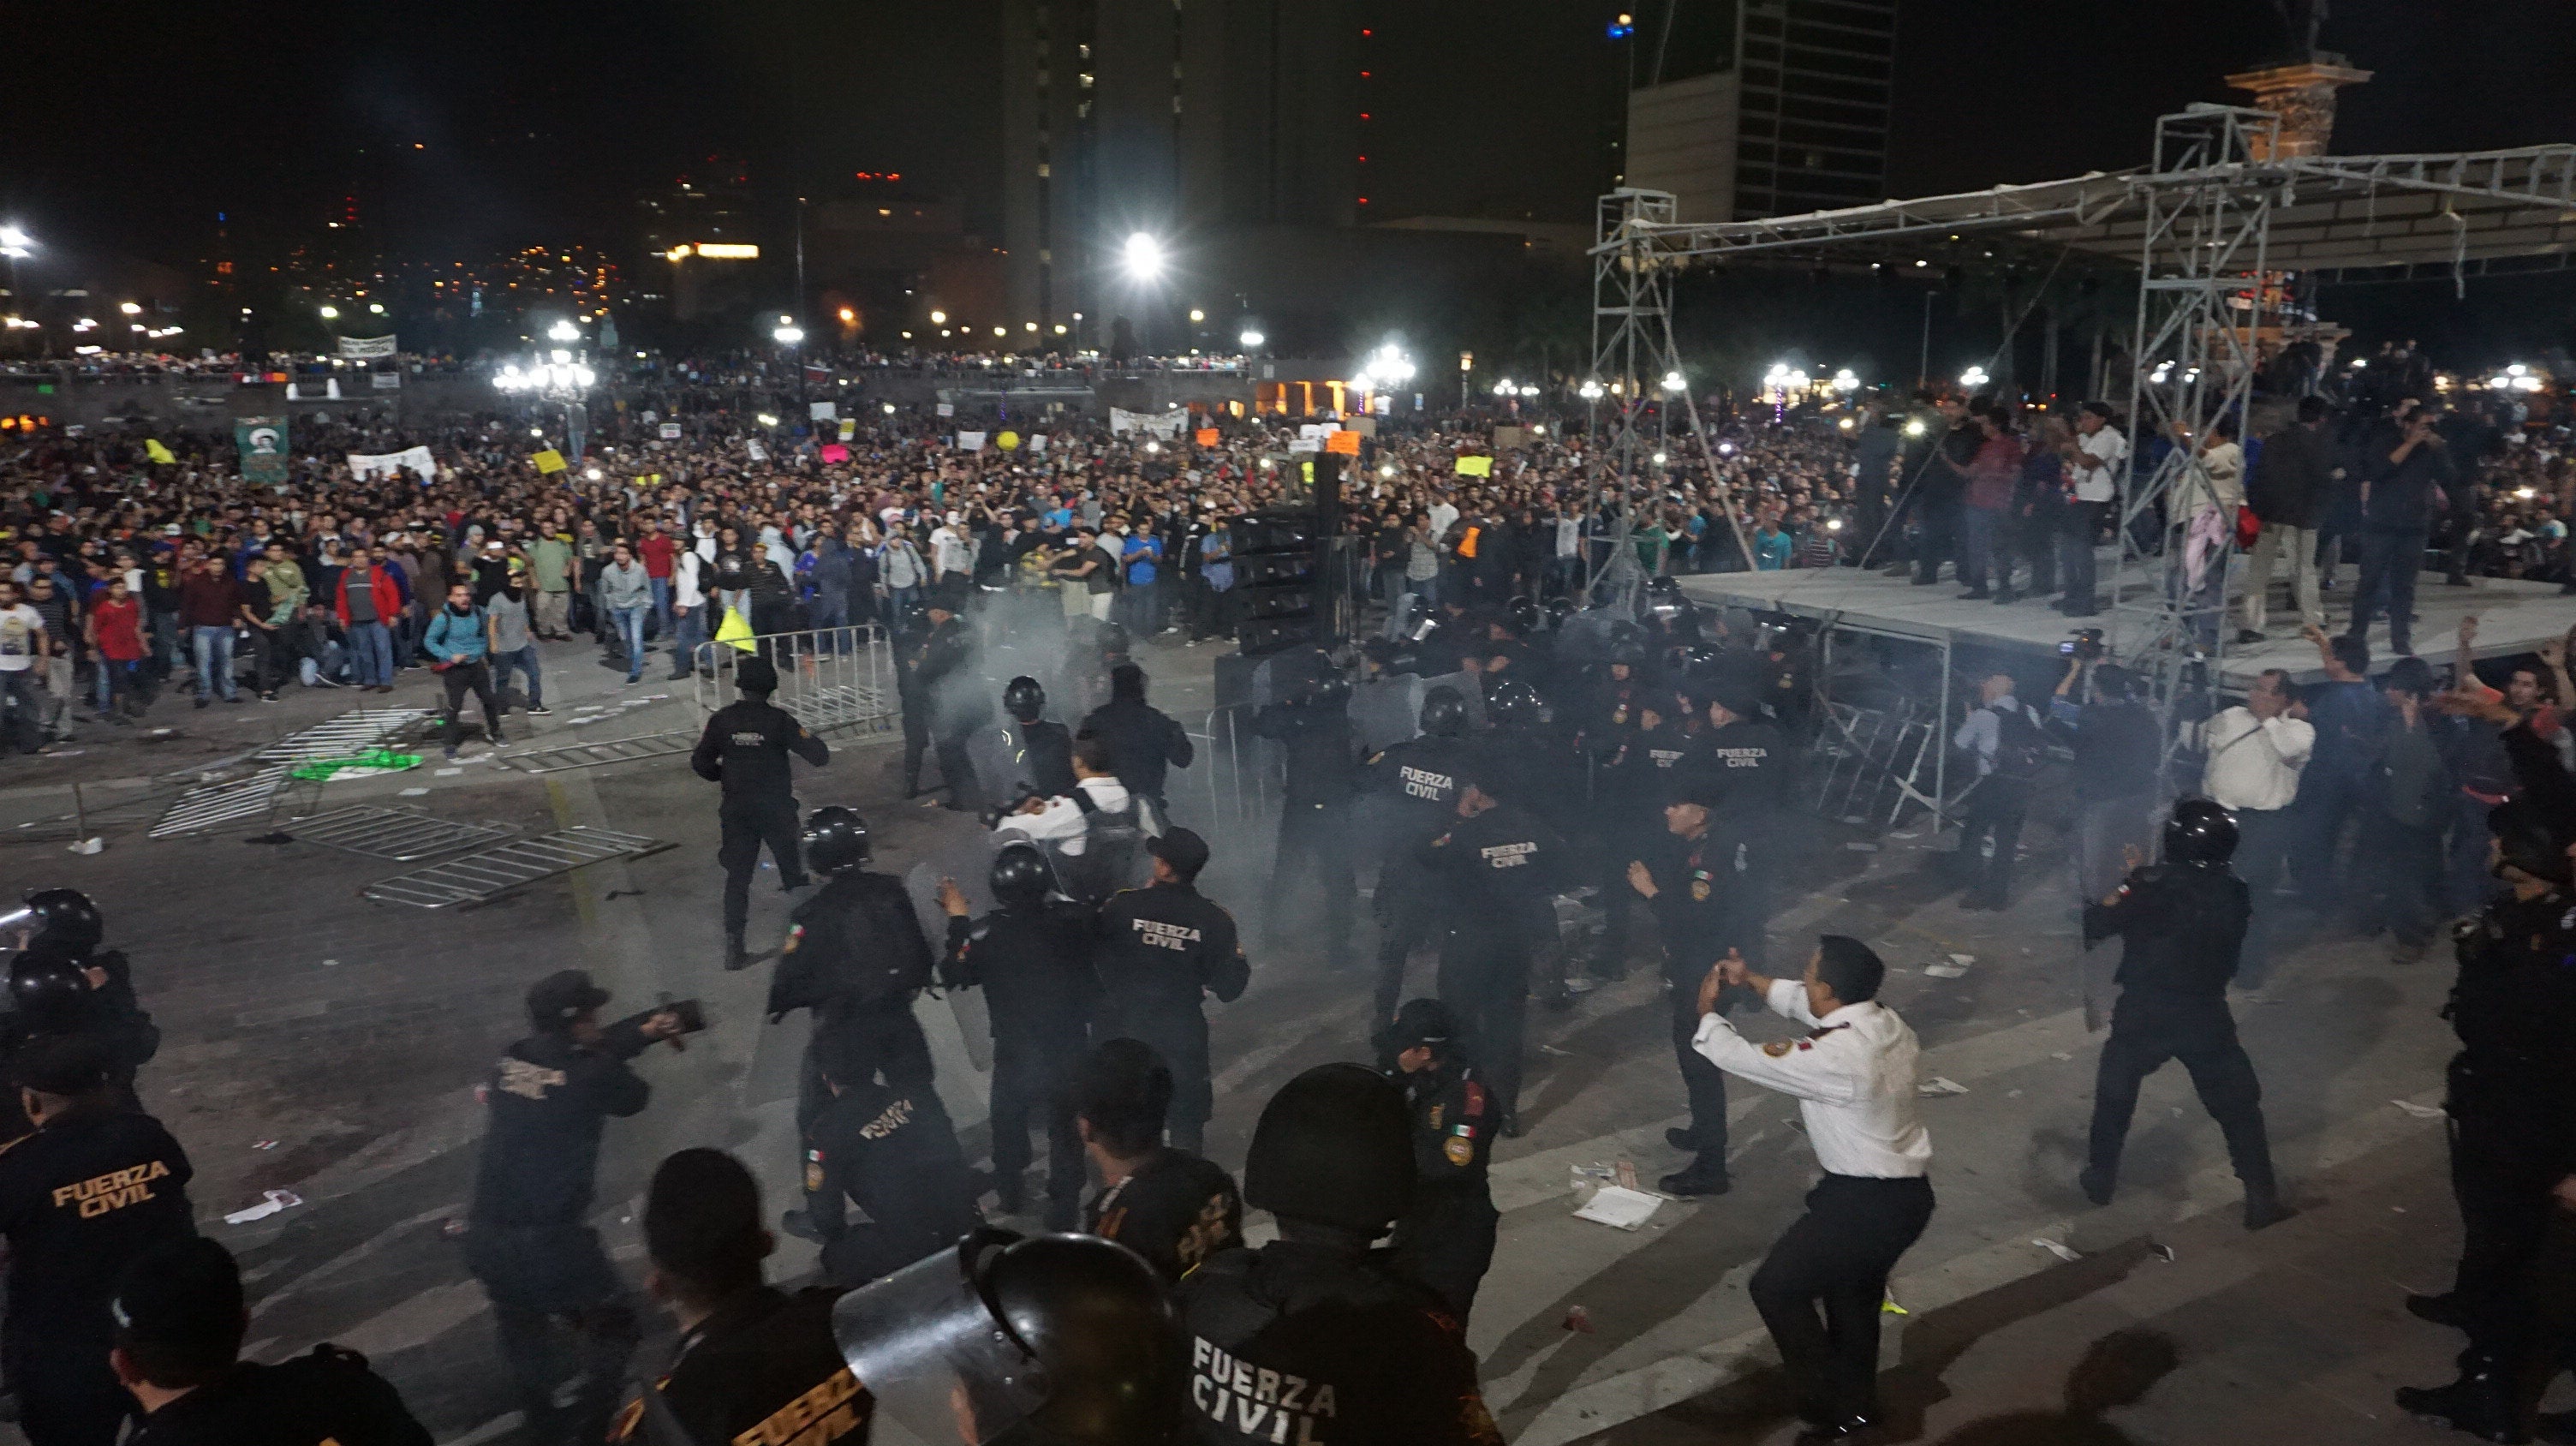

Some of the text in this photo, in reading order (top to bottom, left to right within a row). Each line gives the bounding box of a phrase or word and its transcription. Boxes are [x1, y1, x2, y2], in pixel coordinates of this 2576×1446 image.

[1716, 748, 1768, 759] FUERZA
[1726, 757, 1760, 768] CIVIL
[1400, 766, 1453, 791] FUERZA
[1405, 782, 1440, 802] CIVIL
[1481, 841, 1539, 859] FUERZA
[1491, 855, 1530, 869] CIVIL
[1132, 918, 1202, 943] FUERZA
[1142, 932, 1186, 951] CIVIL
[51, 1160, 171, 1208] FUERZA
[79, 1182, 157, 1219] CIVIL
[1191, 1335, 1337, 1419] FUERZA
[730, 1366, 864, 1446] FUERZ
[1192, 1373, 1325, 1446] CIVIL
